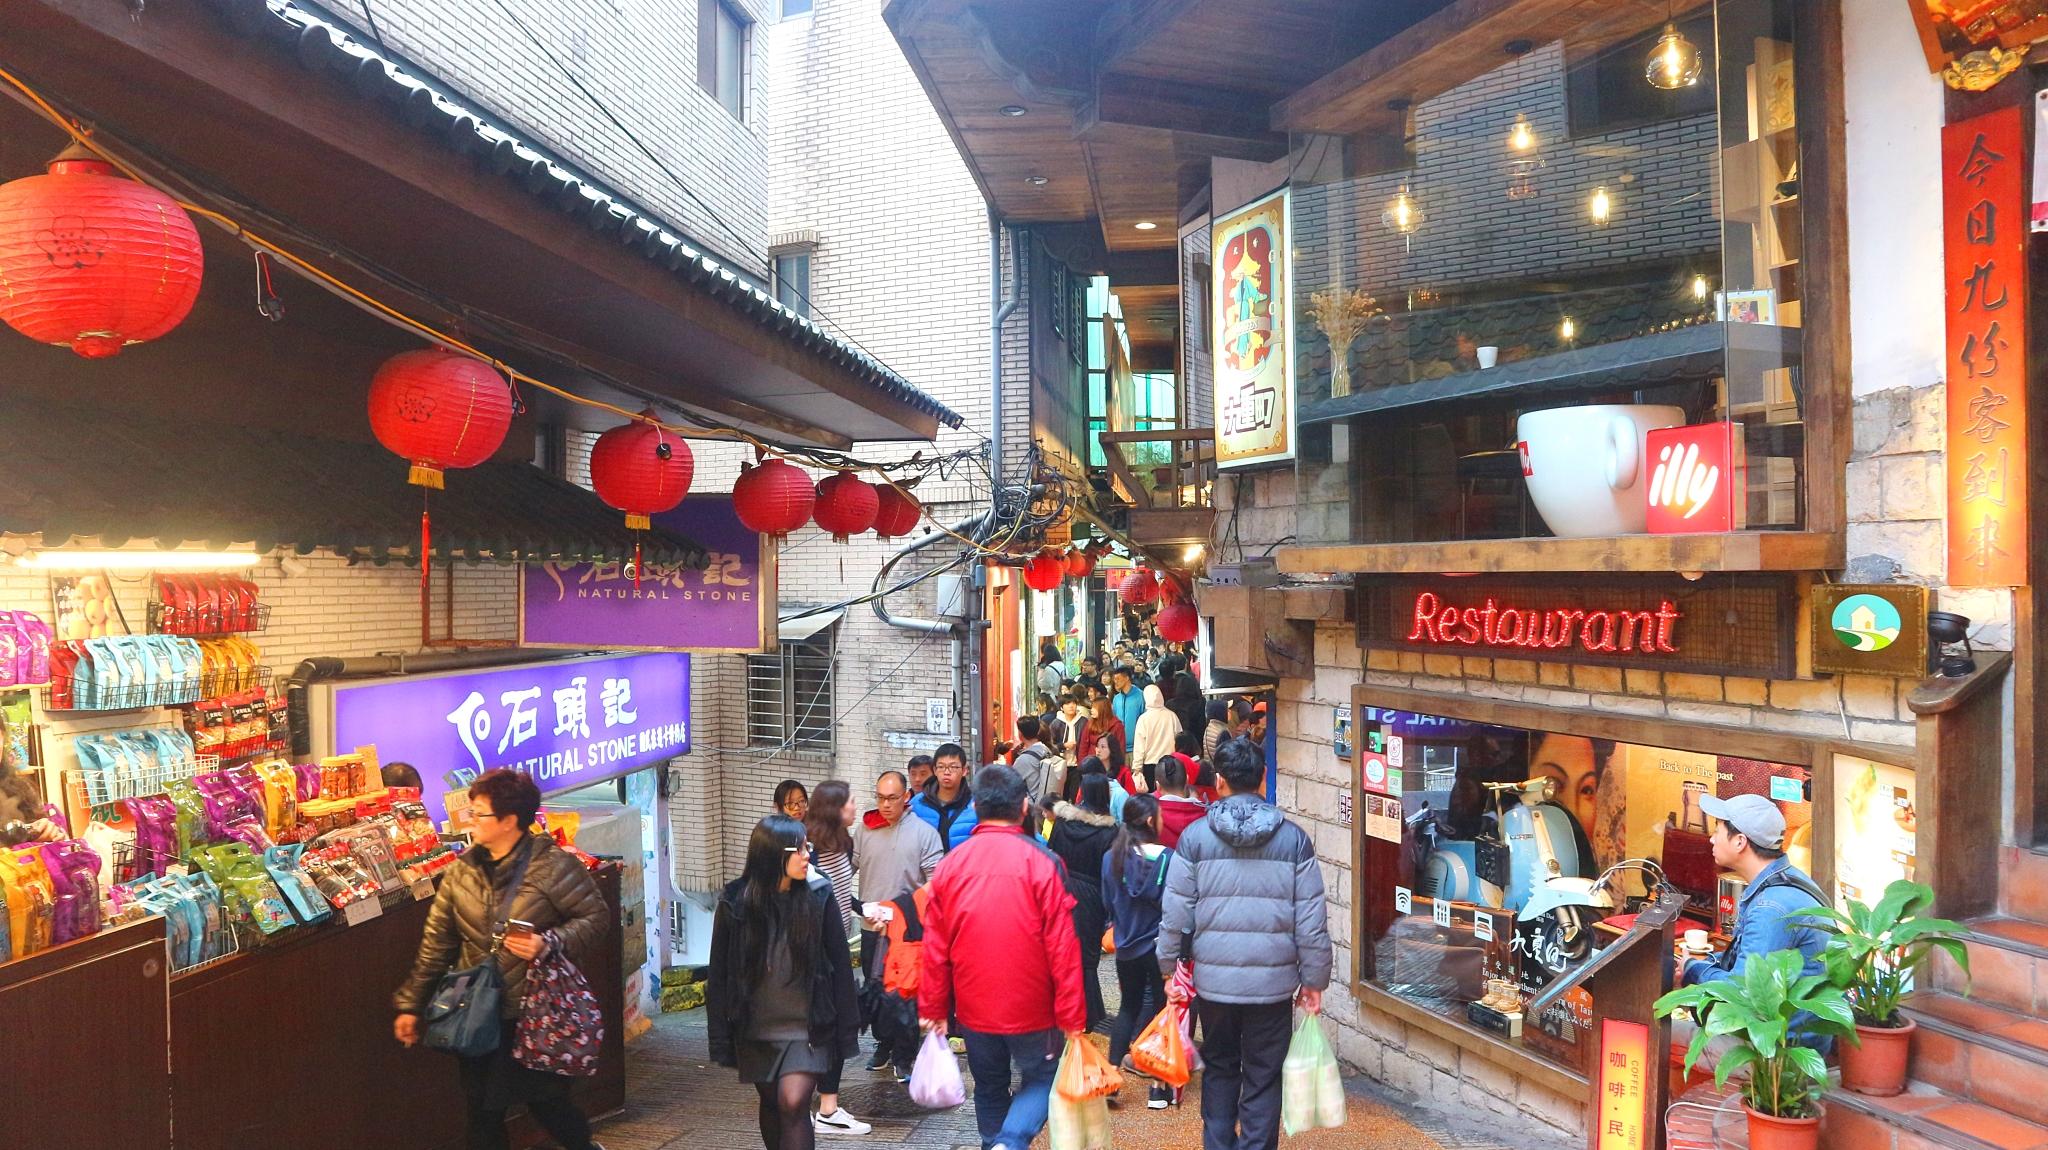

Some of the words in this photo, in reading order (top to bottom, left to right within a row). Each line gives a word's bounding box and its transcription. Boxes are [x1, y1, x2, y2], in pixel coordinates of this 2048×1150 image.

[1958, 132, 2011, 571] 今日九份客到來
[1649, 442, 1719, 519] illy
[578, 588, 669, 600] NATURAL
[683, 590, 751, 602] STONE
[1408, 592, 1678, 652] Restaurant
[498, 676, 638, 755] 石頭記
[588, 734, 637, 766] STONE
[1660, 760, 1681, 773] Back
[1683, 765, 1692, 774] to
[1696, 765, 1713, 778] The
[1716, 771, 1734, 783] past
[1720, 898, 1733, 912] illy
[1630, 1060, 1640, 1098] COFFEE
